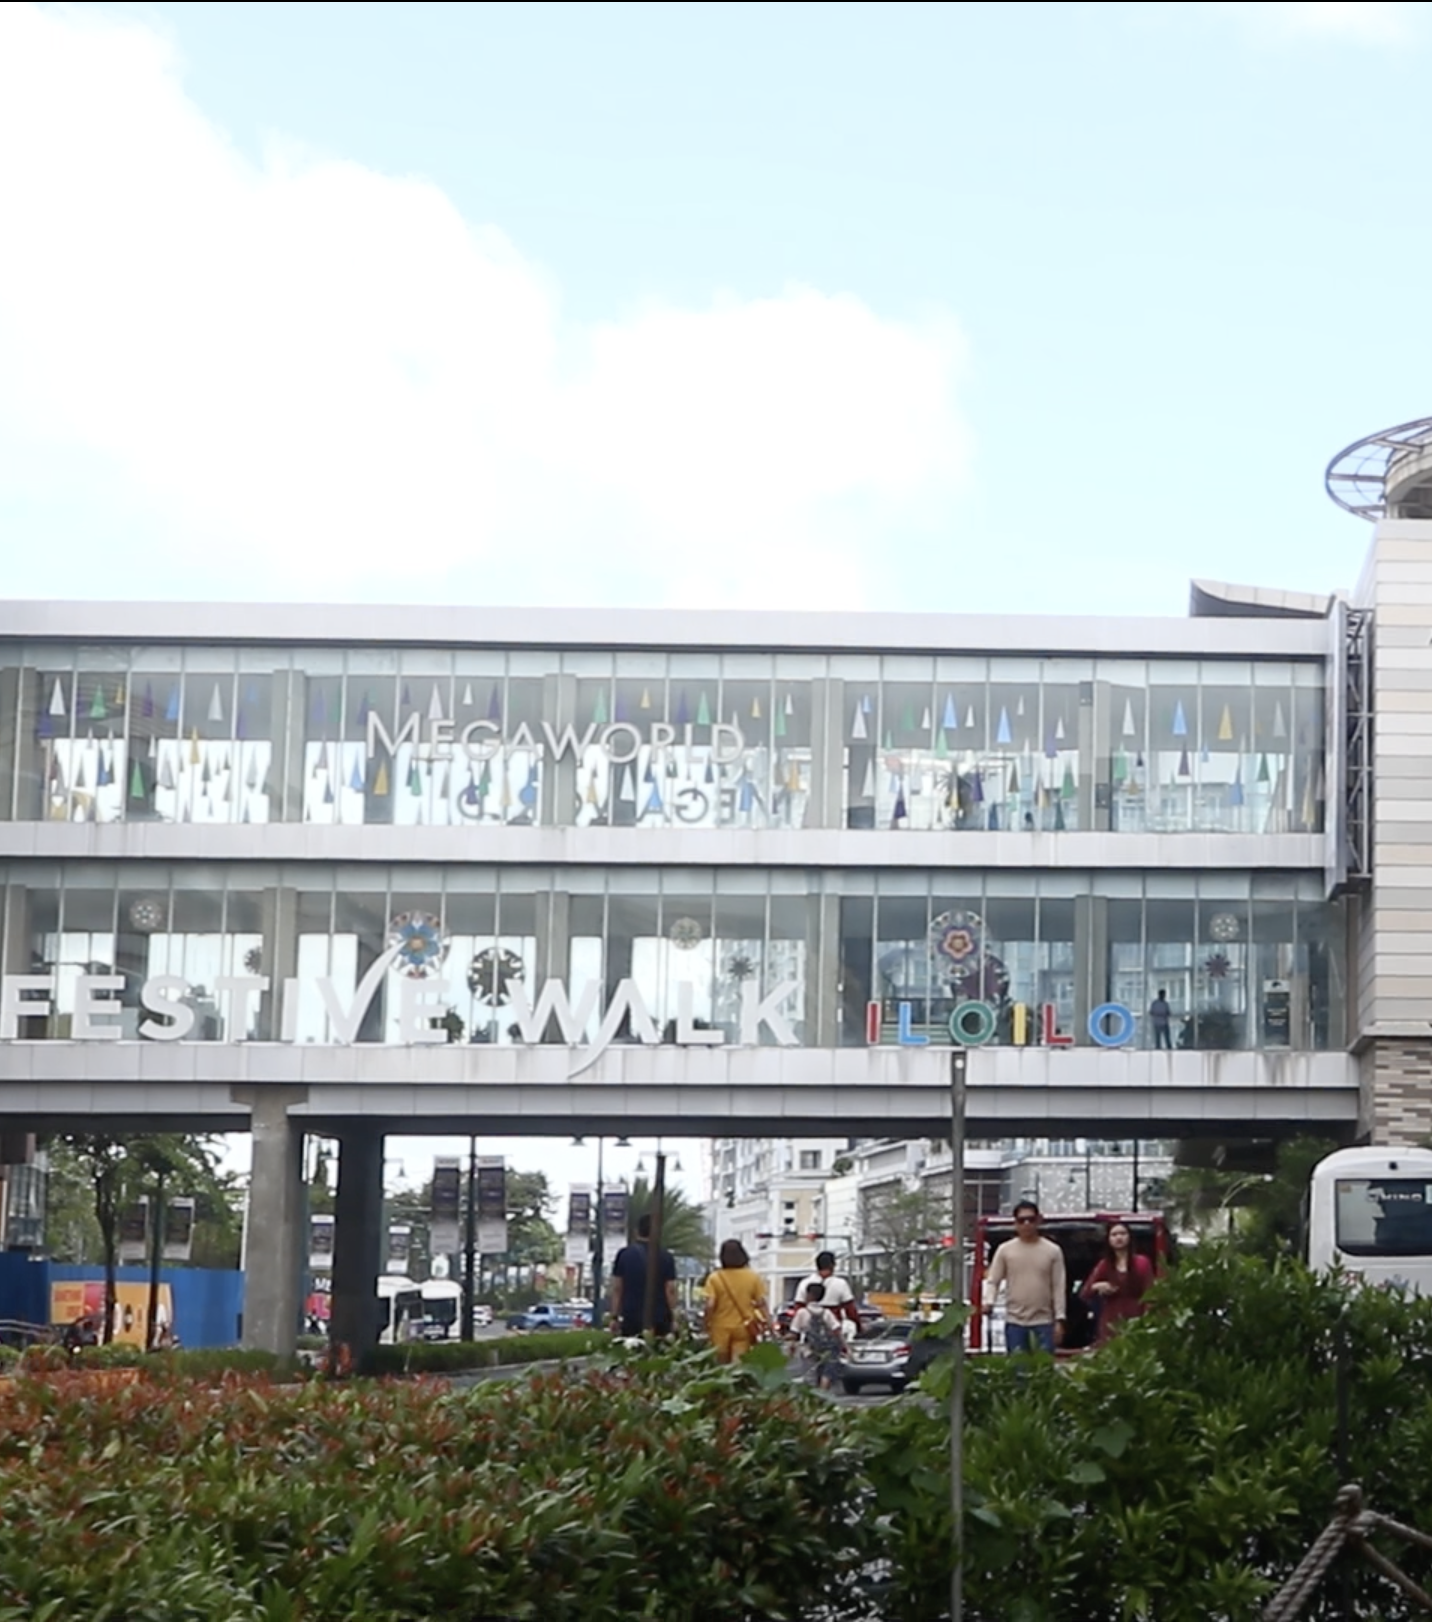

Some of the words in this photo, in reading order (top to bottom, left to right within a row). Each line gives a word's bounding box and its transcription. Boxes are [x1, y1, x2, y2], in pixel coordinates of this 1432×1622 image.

[366, 710, 745, 764] MEGAWORLD
[1, 941, 450, 1045] FESTIVE
[504, 977, 804, 1081] WALK
[866, 1000, 1135, 1047] ILOILO
